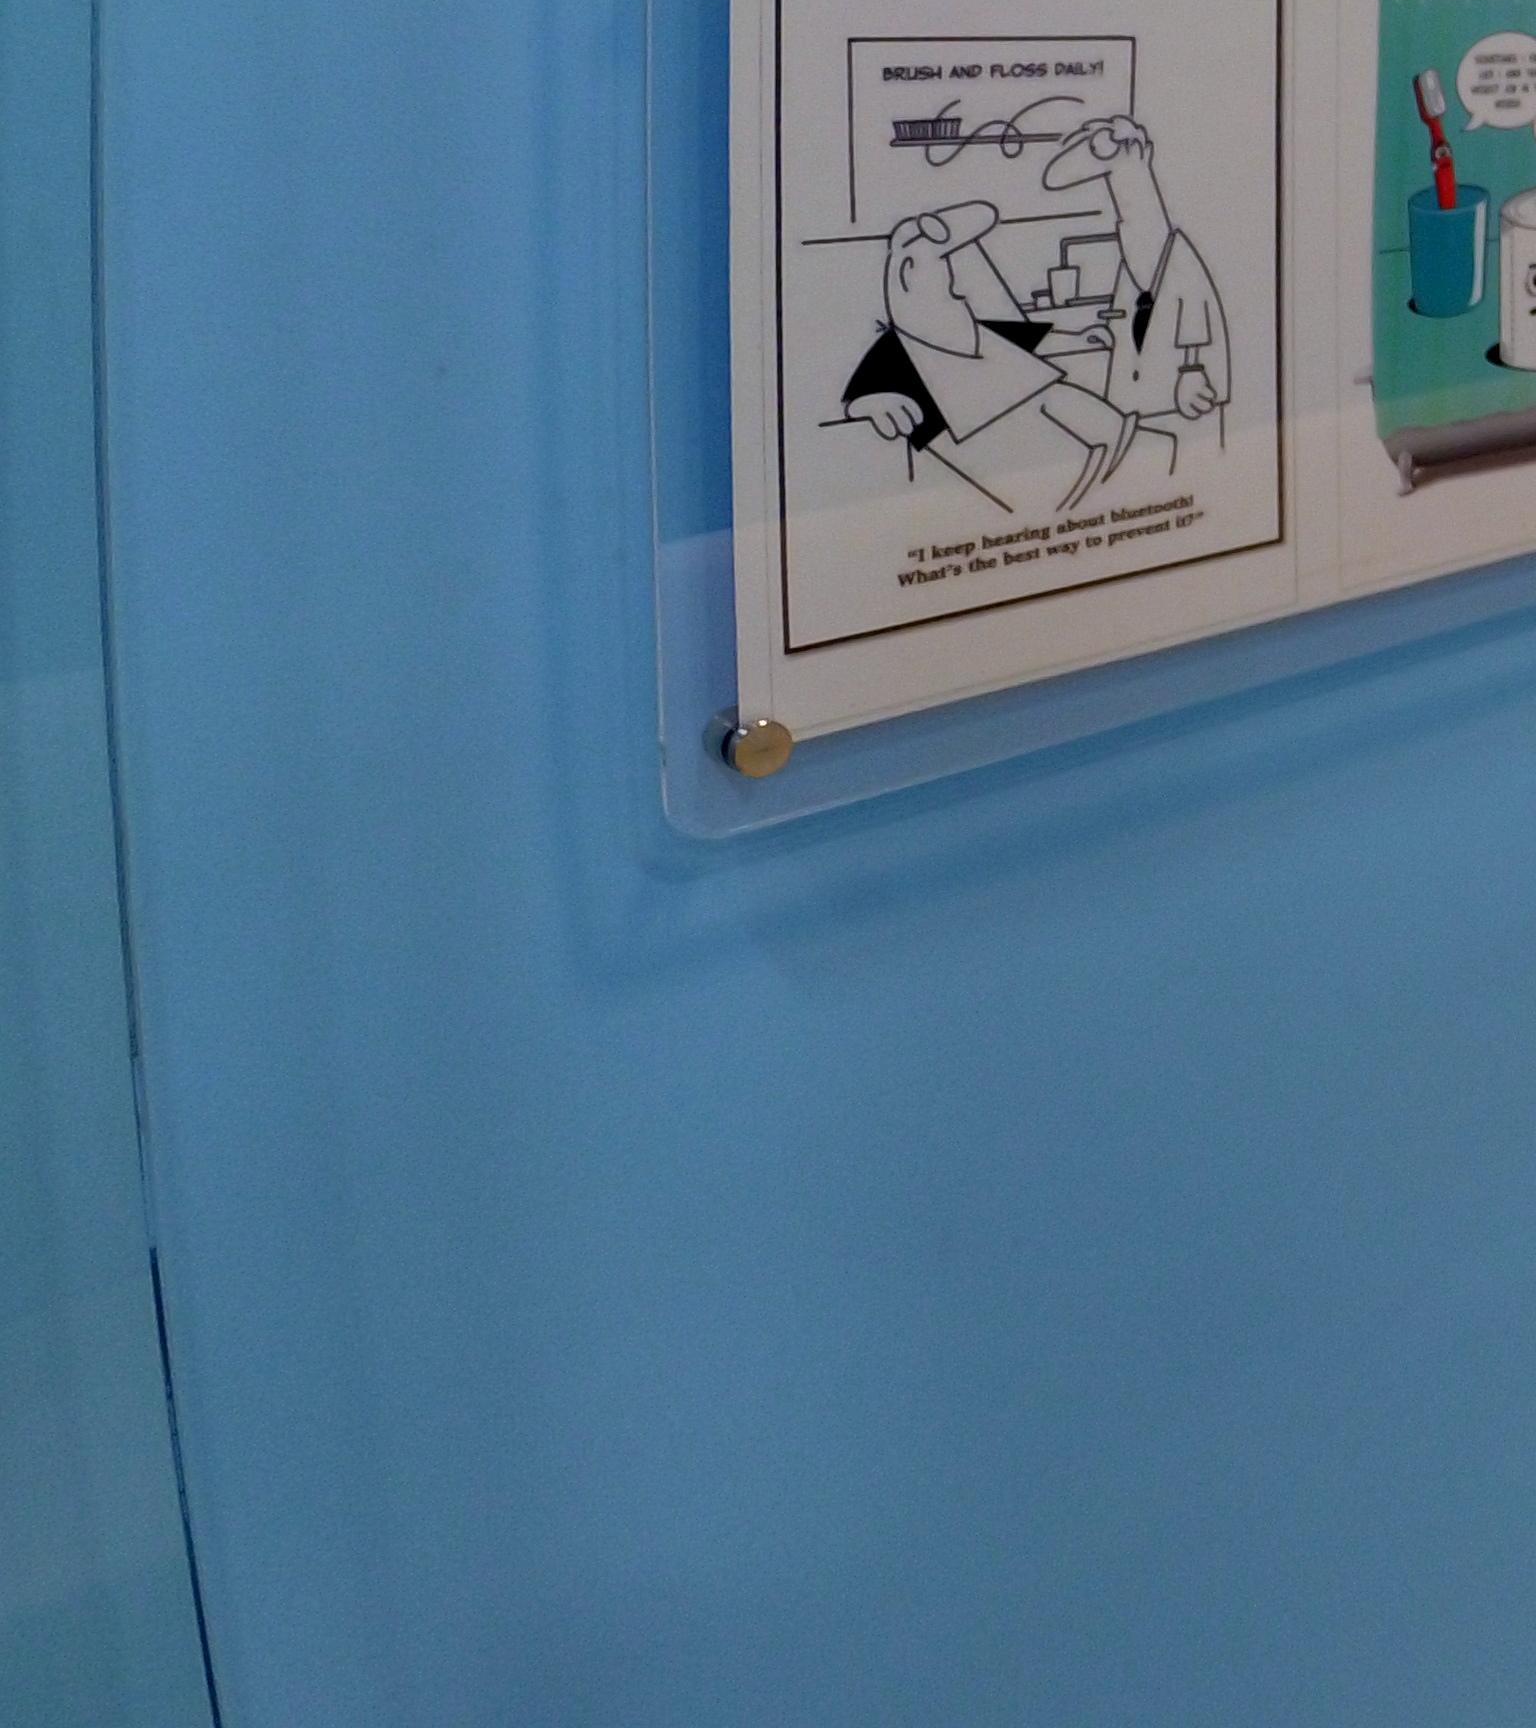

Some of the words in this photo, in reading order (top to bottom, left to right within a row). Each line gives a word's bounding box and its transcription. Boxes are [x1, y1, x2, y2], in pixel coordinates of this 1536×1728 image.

[882, 65, 943, 83] BRUSH
[948, 65, 983, 80] AND
[990, 62, 1048, 79] FLOSS
[897, 563, 962, 588] What's
[968, 556, 998, 573] the
[1003, 547, 1040, 566] best
[1046, 539, 1080, 558] way
[1085, 534, 1103, 549] to
[1108, 521, 1170, 547] prevent
[931, 540, 976, 561] keep
[981, 524, 1051, 550] hearing
[1056, 514, 1106, 536] about
